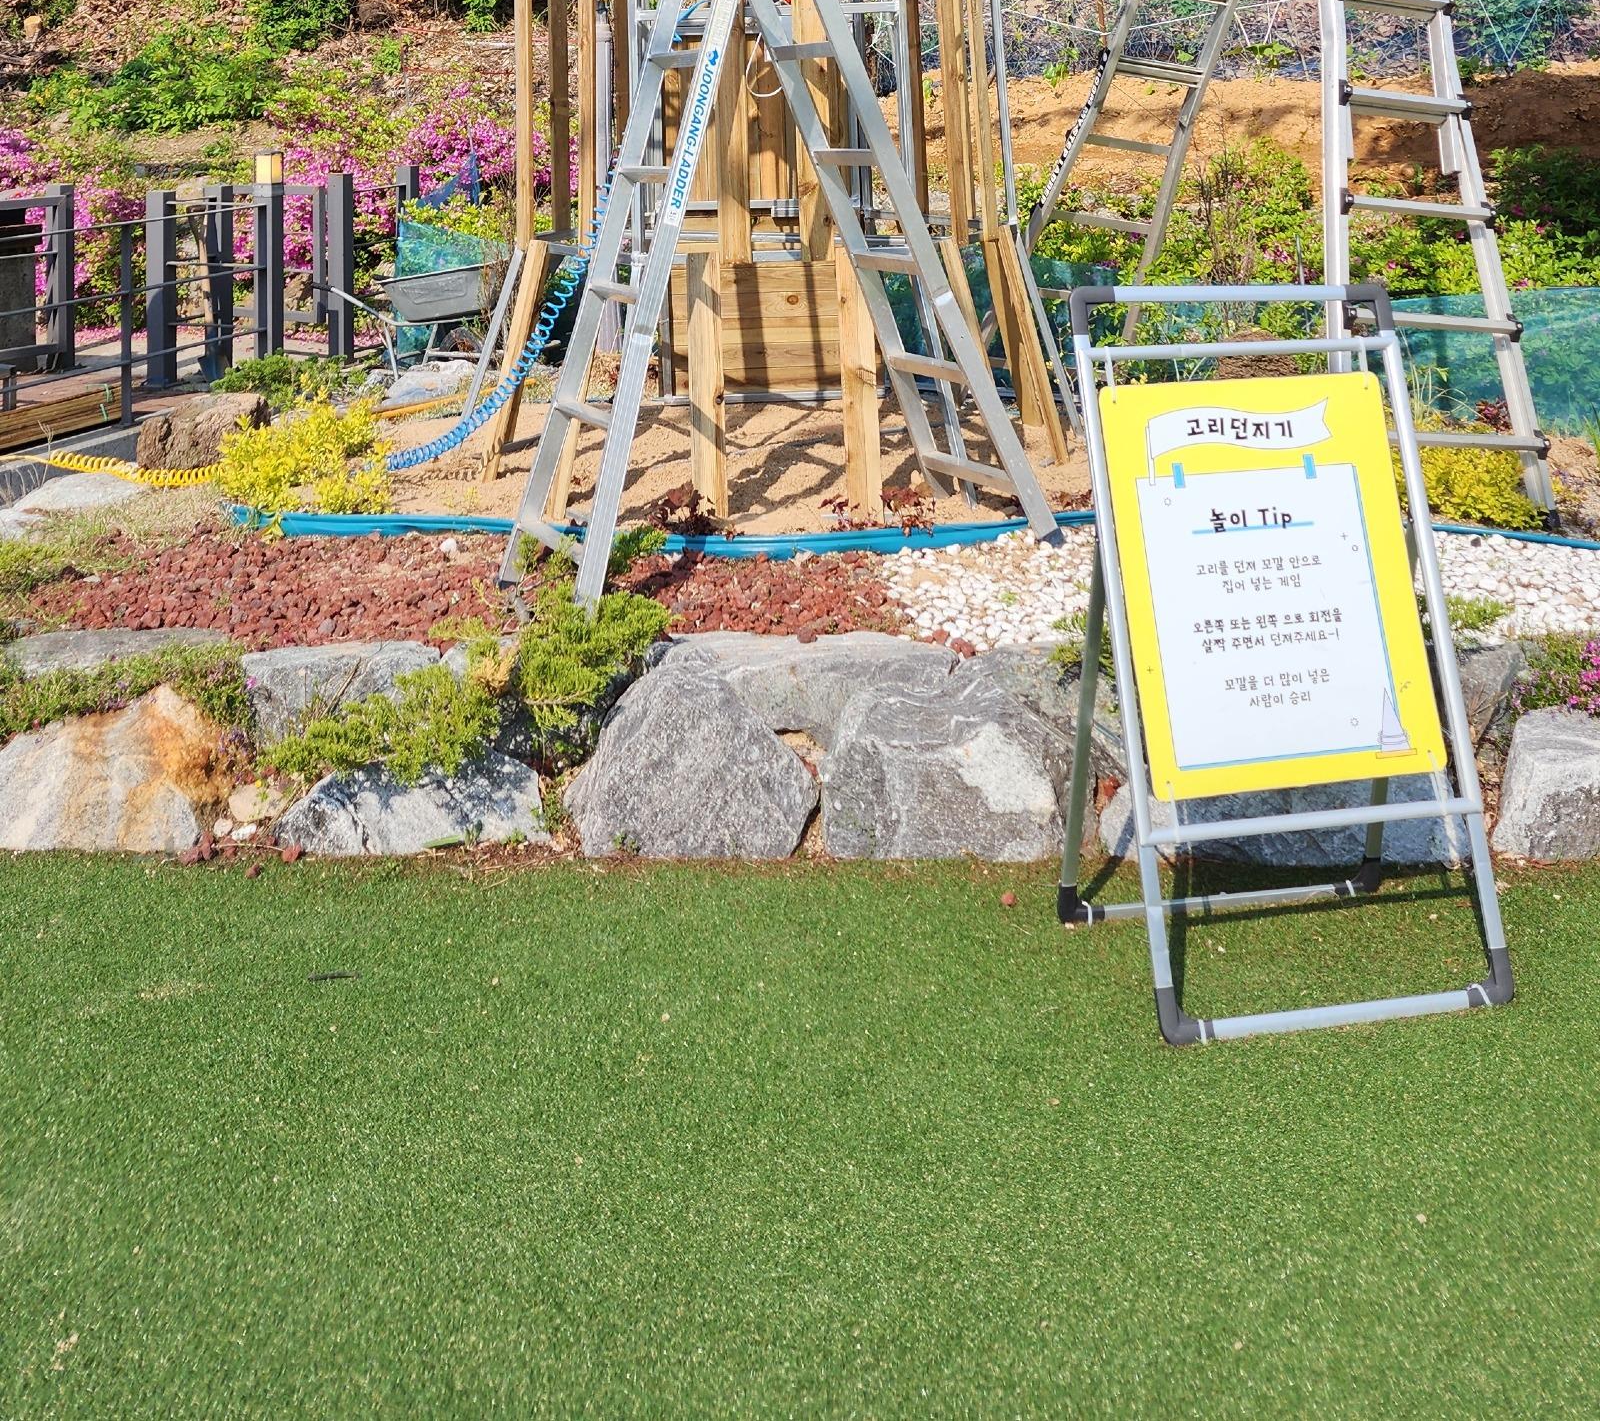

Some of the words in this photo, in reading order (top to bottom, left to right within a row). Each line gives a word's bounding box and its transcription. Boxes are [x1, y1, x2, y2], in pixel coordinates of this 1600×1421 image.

[1186, 417, 1294, 440] 고리던지기
[1209, 508, 1249, 534] 놀이
[1257, 506, 1293, 530] Tip
[1196, 560, 1229, 576] 고리를
[1234, 560, 1257, 574] 던져
[1262, 556, 1285, 571] 꼬깔
[1289, 555, 1323, 569] 안으로
[1222, 580, 1246, 594] 집어
[1250, 576, 1273, 592] 넣는
[1278, 573, 1302, 588] 게임
[1193, 619, 1225, 634] 오른쪽
[1230, 616, 1251, 630] 또는
[1255, 614, 1278, 629] 왼쪽
[1283, 613, 1305, 625] 으로
[1309, 607, 1343, 623] 회전을
[1202, 637, 1226, 654] 살짝
[1231, 635, 1265, 650] 주면서
[1225, 675, 1258, 692] 꼬깔을
[1263, 675, 1275, 687] 더
[1279, 672, 1302, 687] 많이
[1307, 668, 1330, 684] 넣은
[1249, 692, 1284, 708] 사람이
[1289, 690, 1312, 706] 승리
